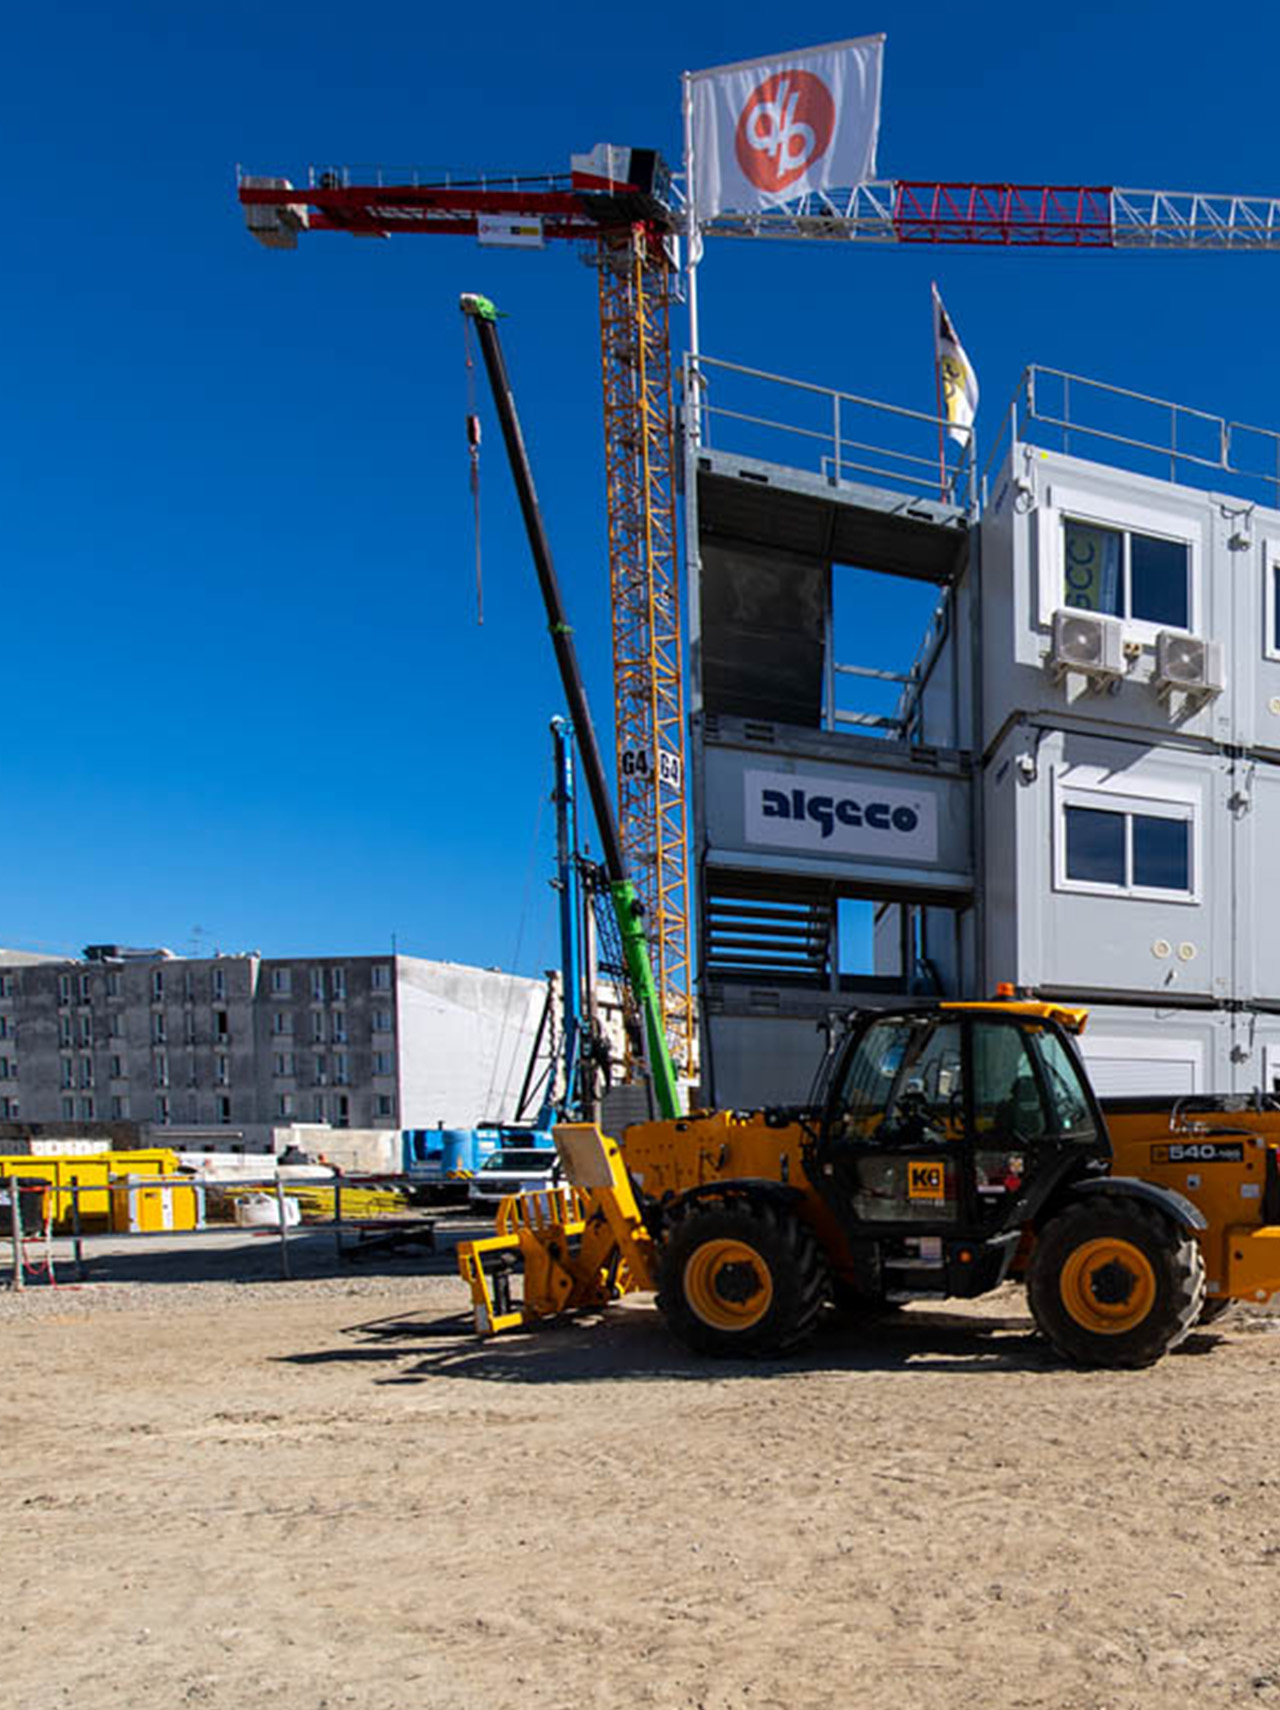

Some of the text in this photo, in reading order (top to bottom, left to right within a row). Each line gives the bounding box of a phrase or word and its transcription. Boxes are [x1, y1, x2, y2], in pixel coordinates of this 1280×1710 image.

[622, 750, 648, 775] G4
[661, 753, 678, 783] G4
[762, 789, 918, 838] algeco
